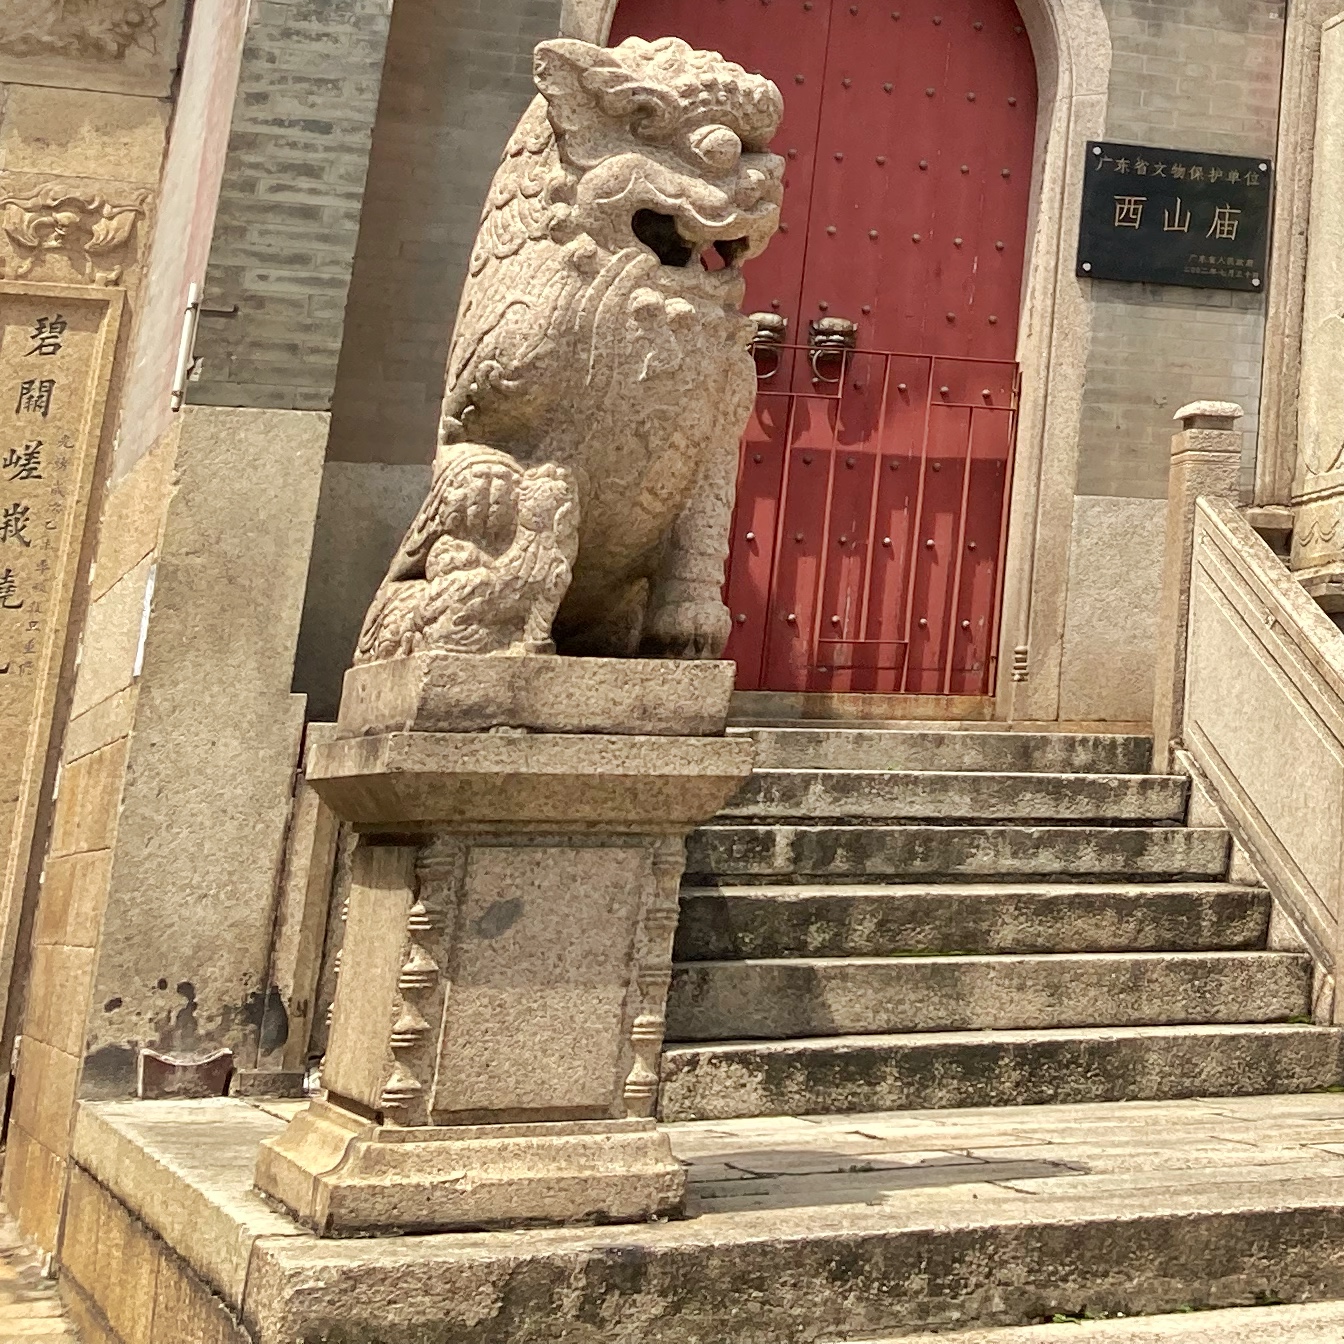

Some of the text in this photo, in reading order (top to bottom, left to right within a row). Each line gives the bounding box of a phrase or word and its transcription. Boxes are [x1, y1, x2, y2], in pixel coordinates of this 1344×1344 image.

[1094, 155, 1261, 187] 广东省文物保护单位
[1112, 194, 1242, 241] 西山庙
[1187, 253, 1255, 268] 广东省人民政府
